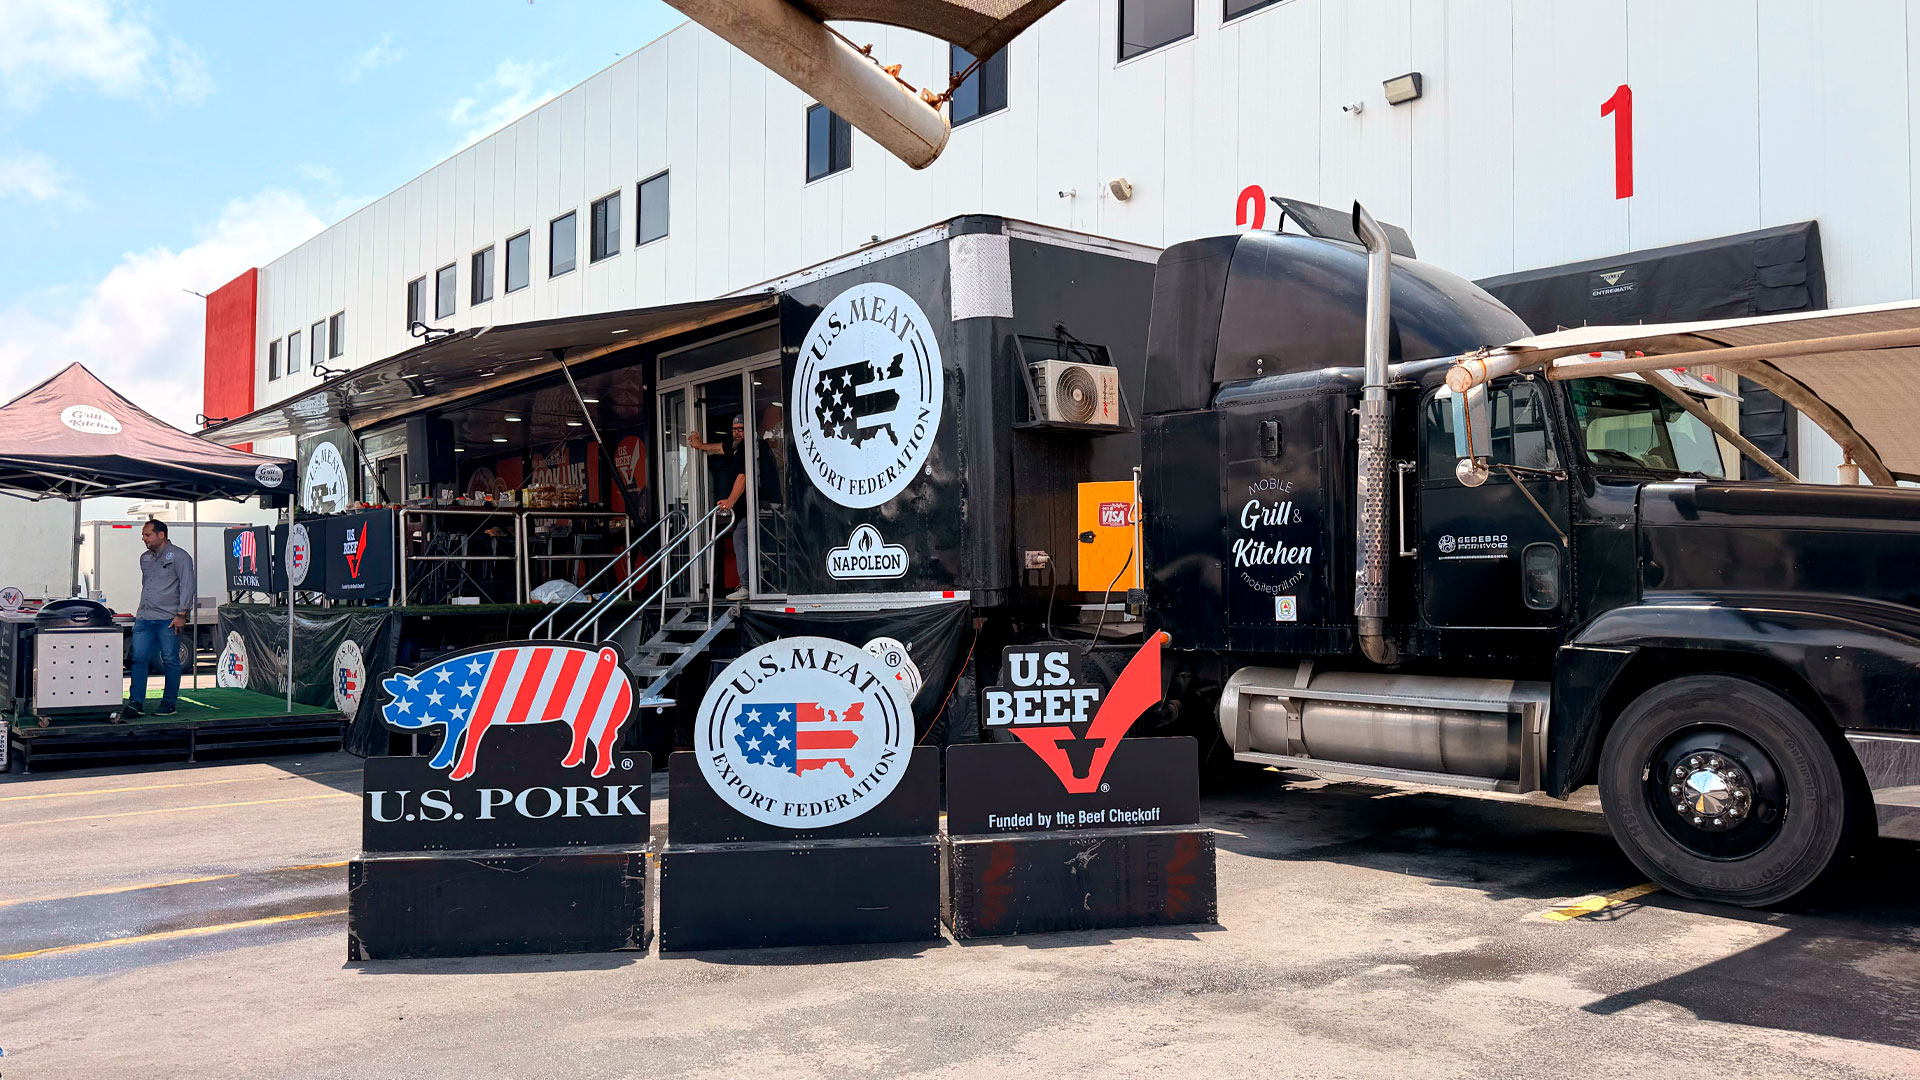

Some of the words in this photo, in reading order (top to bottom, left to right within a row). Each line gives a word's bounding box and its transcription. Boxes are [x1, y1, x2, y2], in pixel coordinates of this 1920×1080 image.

[1600, 84, 1633, 199] 1
[1592, 284, 1634, 297] ENTREMATIC
[811, 312, 847, 361] U.S.
[850, 296, 916, 342] MEAT
[615, 455, 632, 468] BEEF
[802, 427, 846, 493] EXPORT
[849, 407, 931, 495] FEDERATION
[1248, 478, 1294, 496] MOBILE
[1102, 510, 1125, 525] VISA
[1240, 499, 1293, 531] Grill
[833, 554, 901, 571] NAPOLEON
[1232, 538, 1313, 568] Kitchen
[1241, 570, 1305, 596] mobilegrill.mx
[730, 654, 786, 695] U.S.
[790, 648, 881, 694] MEAT
[1009, 652, 1076, 687] U.S.
[986, 688, 1099, 726] BEEF
[712, 752, 778, 813] EXPORT
[783, 748, 897, 817] FEDERATION
[366, 789, 464, 823] U.S.
[475, 784, 647, 820] PORK
[988, 812, 1033, 828] Funded
[1037, 813, 1052, 829] by
[1056, 811, 1075, 825] the
[1078, 809, 1106, 824] Beef
[1109, 807, 1161, 823] Checkoff
